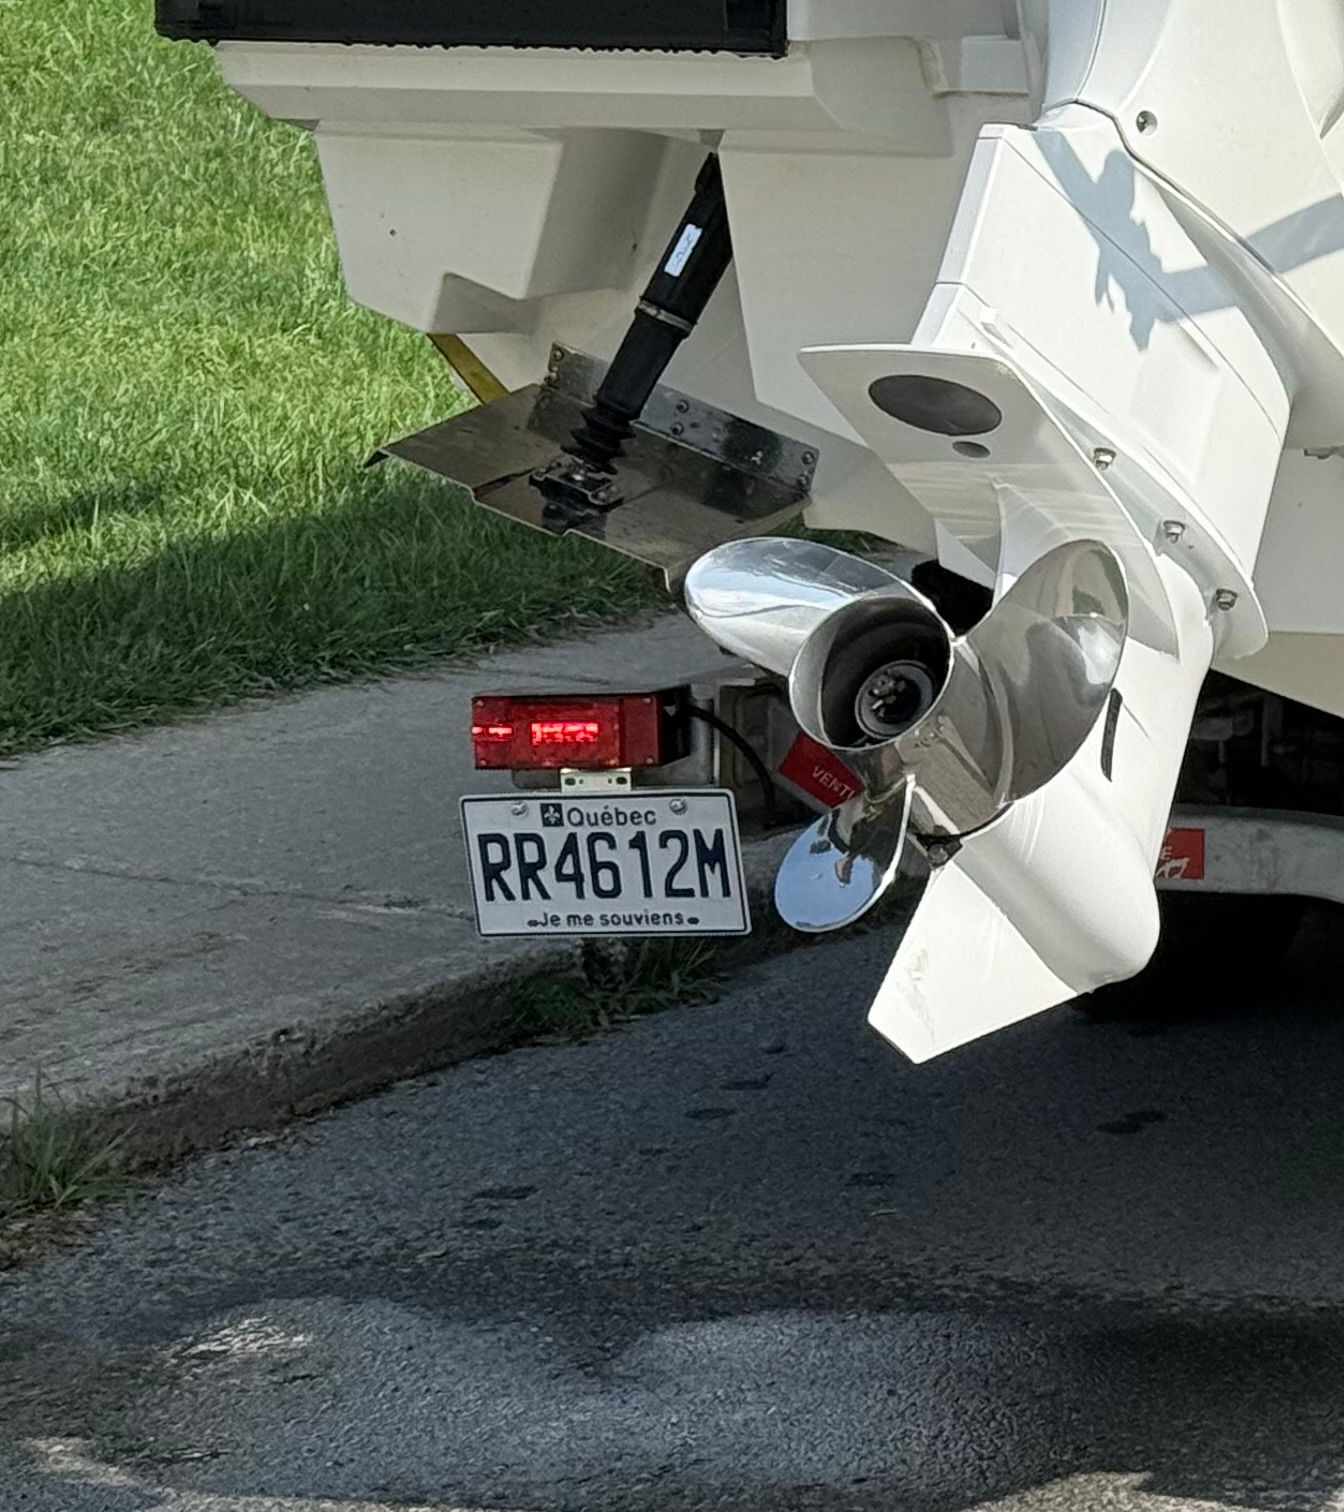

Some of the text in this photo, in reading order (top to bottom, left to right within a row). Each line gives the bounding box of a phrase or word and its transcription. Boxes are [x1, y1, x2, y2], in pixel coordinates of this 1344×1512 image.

[566, 804, 657, 827] Québec
[477, 827, 732, 902] RR4612M
[538, 908, 684, 927] Je me souviens
